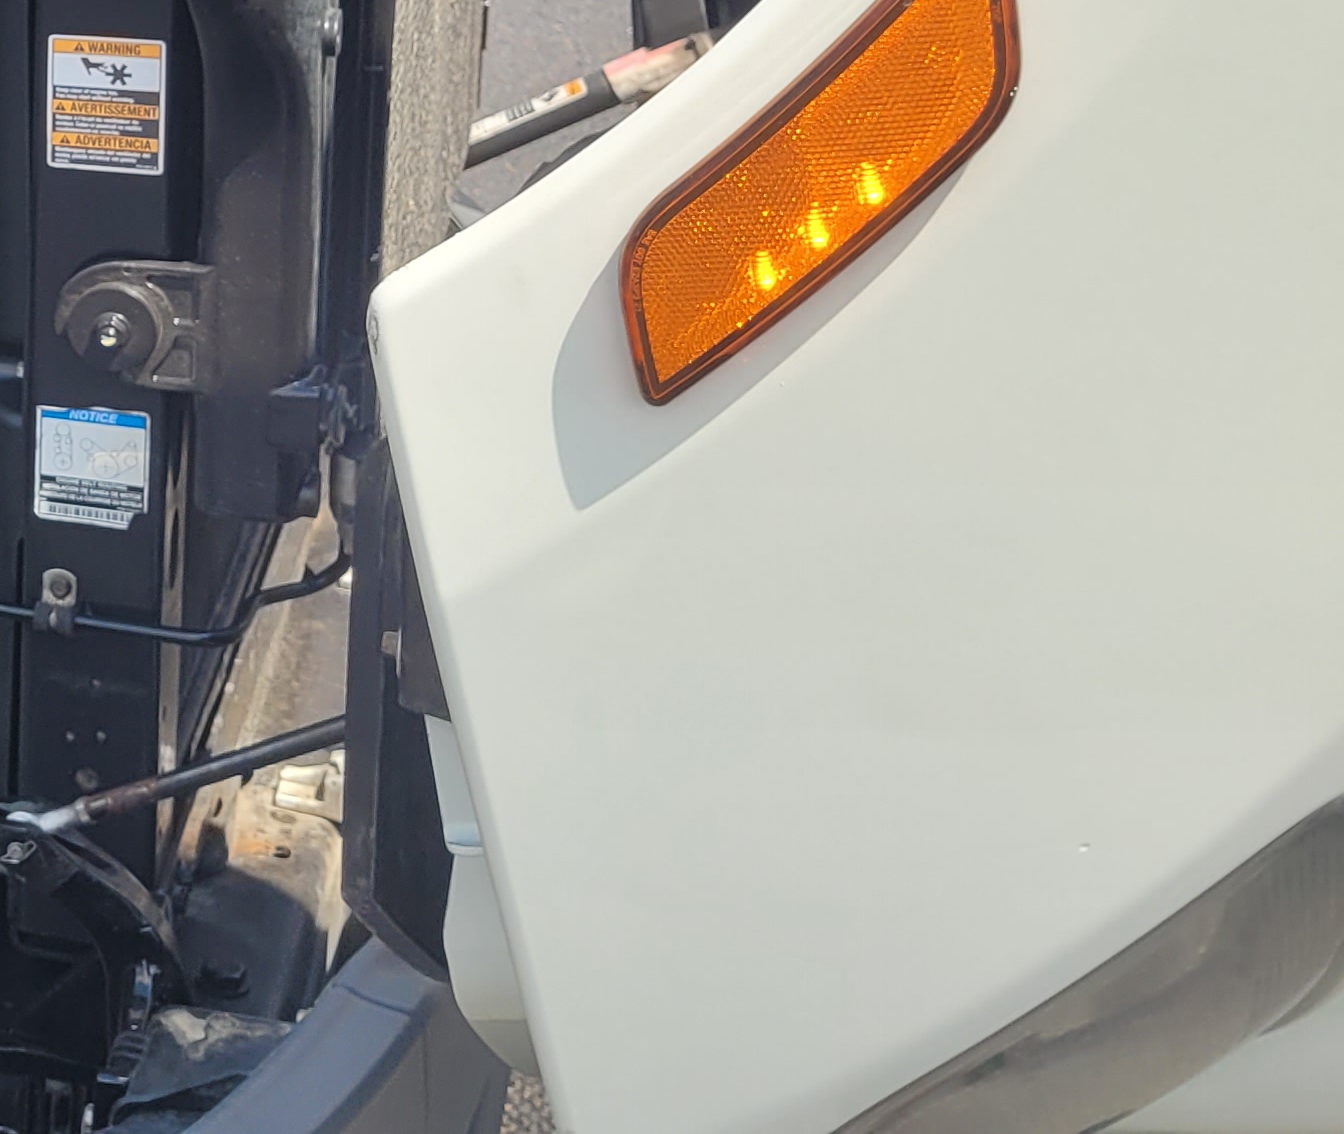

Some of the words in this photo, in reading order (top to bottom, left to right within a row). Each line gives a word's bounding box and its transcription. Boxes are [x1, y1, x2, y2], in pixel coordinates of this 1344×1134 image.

[88, 41, 141, 56] WARNING
[70, 101, 157, 118] AVERTISSEMENT
[75, 135, 152, 150] ADVERTENCIA
[69, 409, 119, 424] NOTICE
